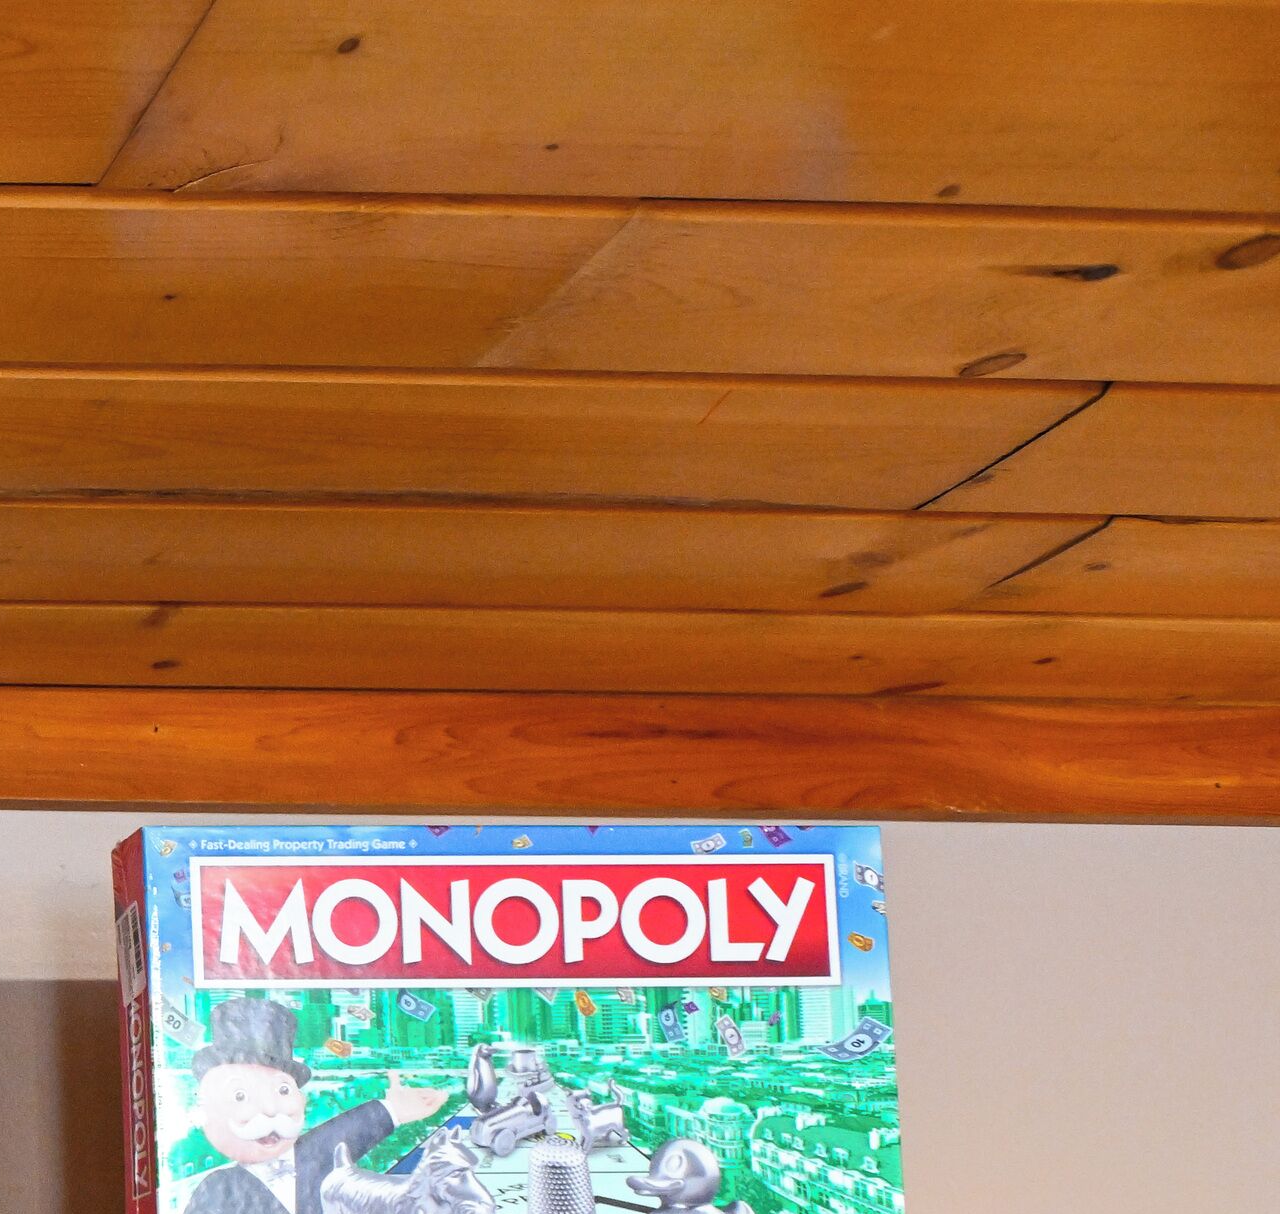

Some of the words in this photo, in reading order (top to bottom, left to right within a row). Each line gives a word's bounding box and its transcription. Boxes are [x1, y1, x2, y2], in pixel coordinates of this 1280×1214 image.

[200, 838, 270, 852] Fast-Dealing
[273, 839, 324, 852] Property
[327, 839, 369, 852] Trading
[371, 839, 406, 850] Game
[220, 876, 815, 966] MONOPOLY
